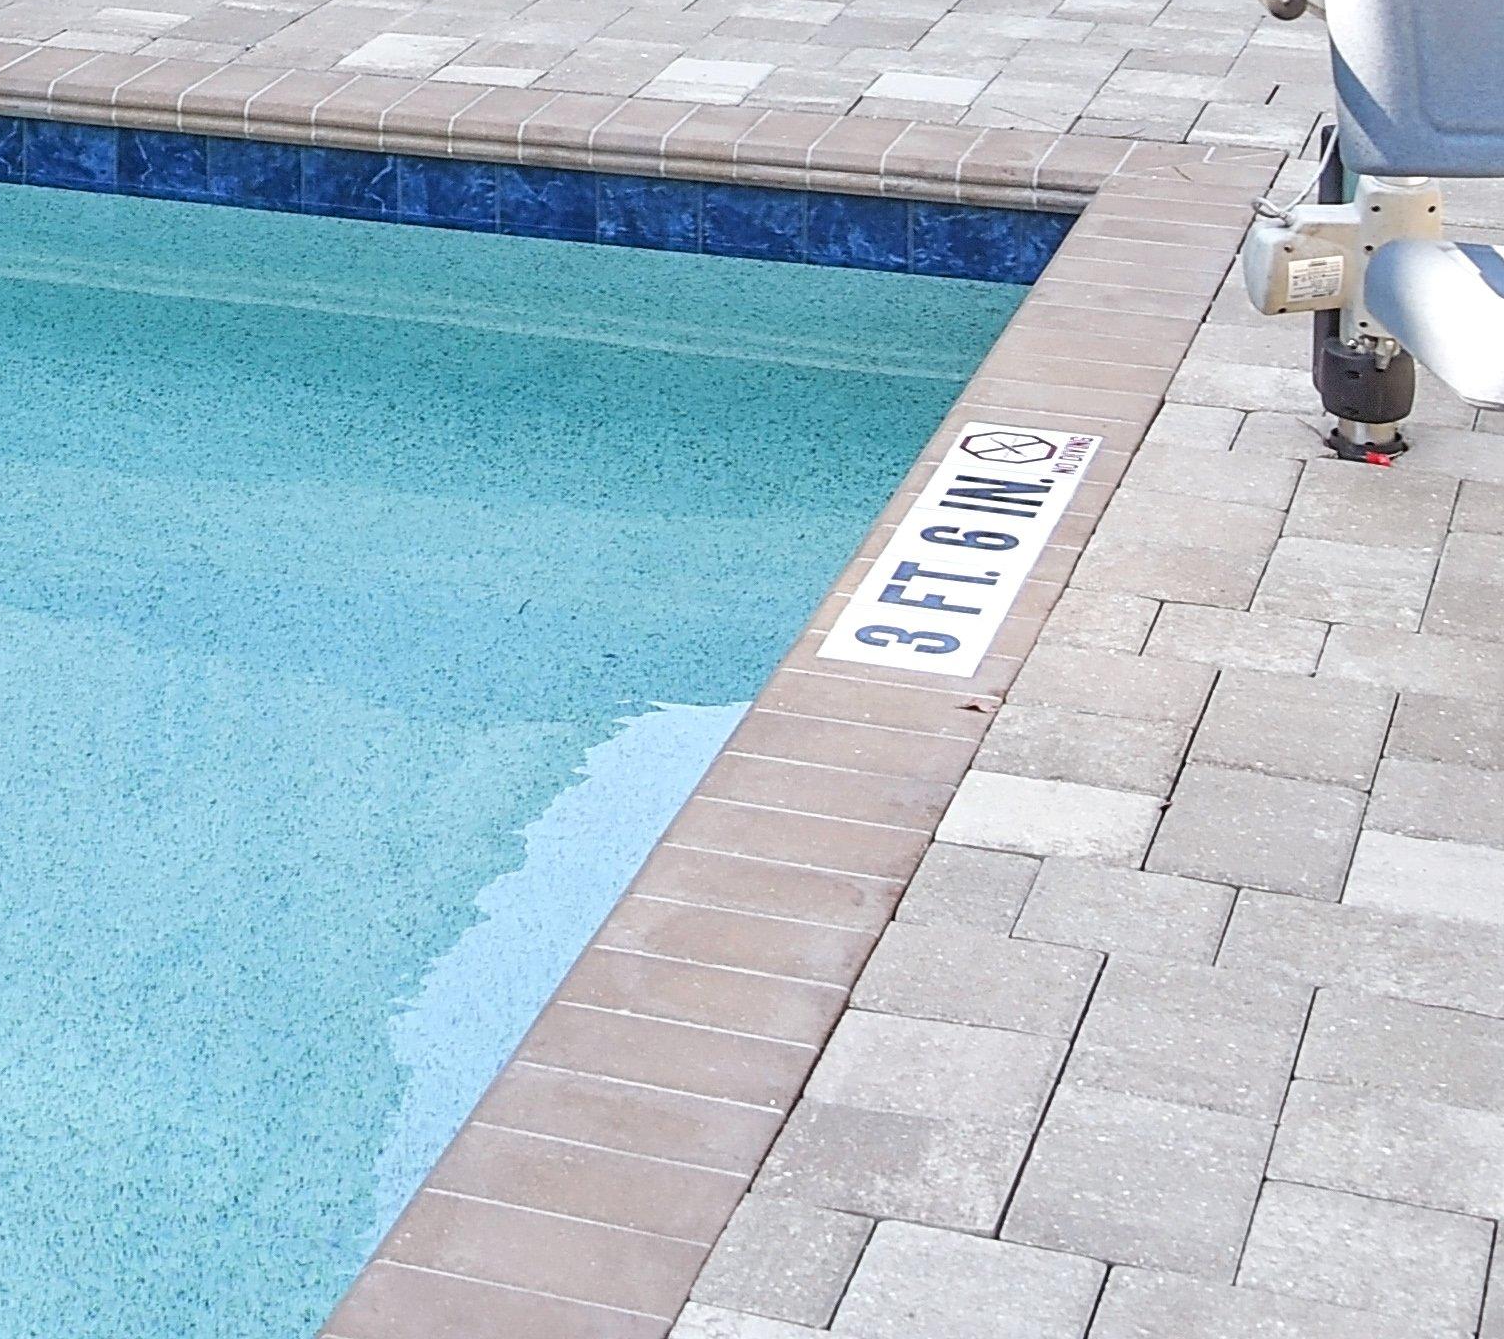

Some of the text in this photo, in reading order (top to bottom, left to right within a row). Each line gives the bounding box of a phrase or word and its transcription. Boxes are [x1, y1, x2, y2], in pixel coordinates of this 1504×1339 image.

[1051, 436, 1094, 474] NO DIVING
[854, 474, 1056, 655] 3 FT. 6 IN.
